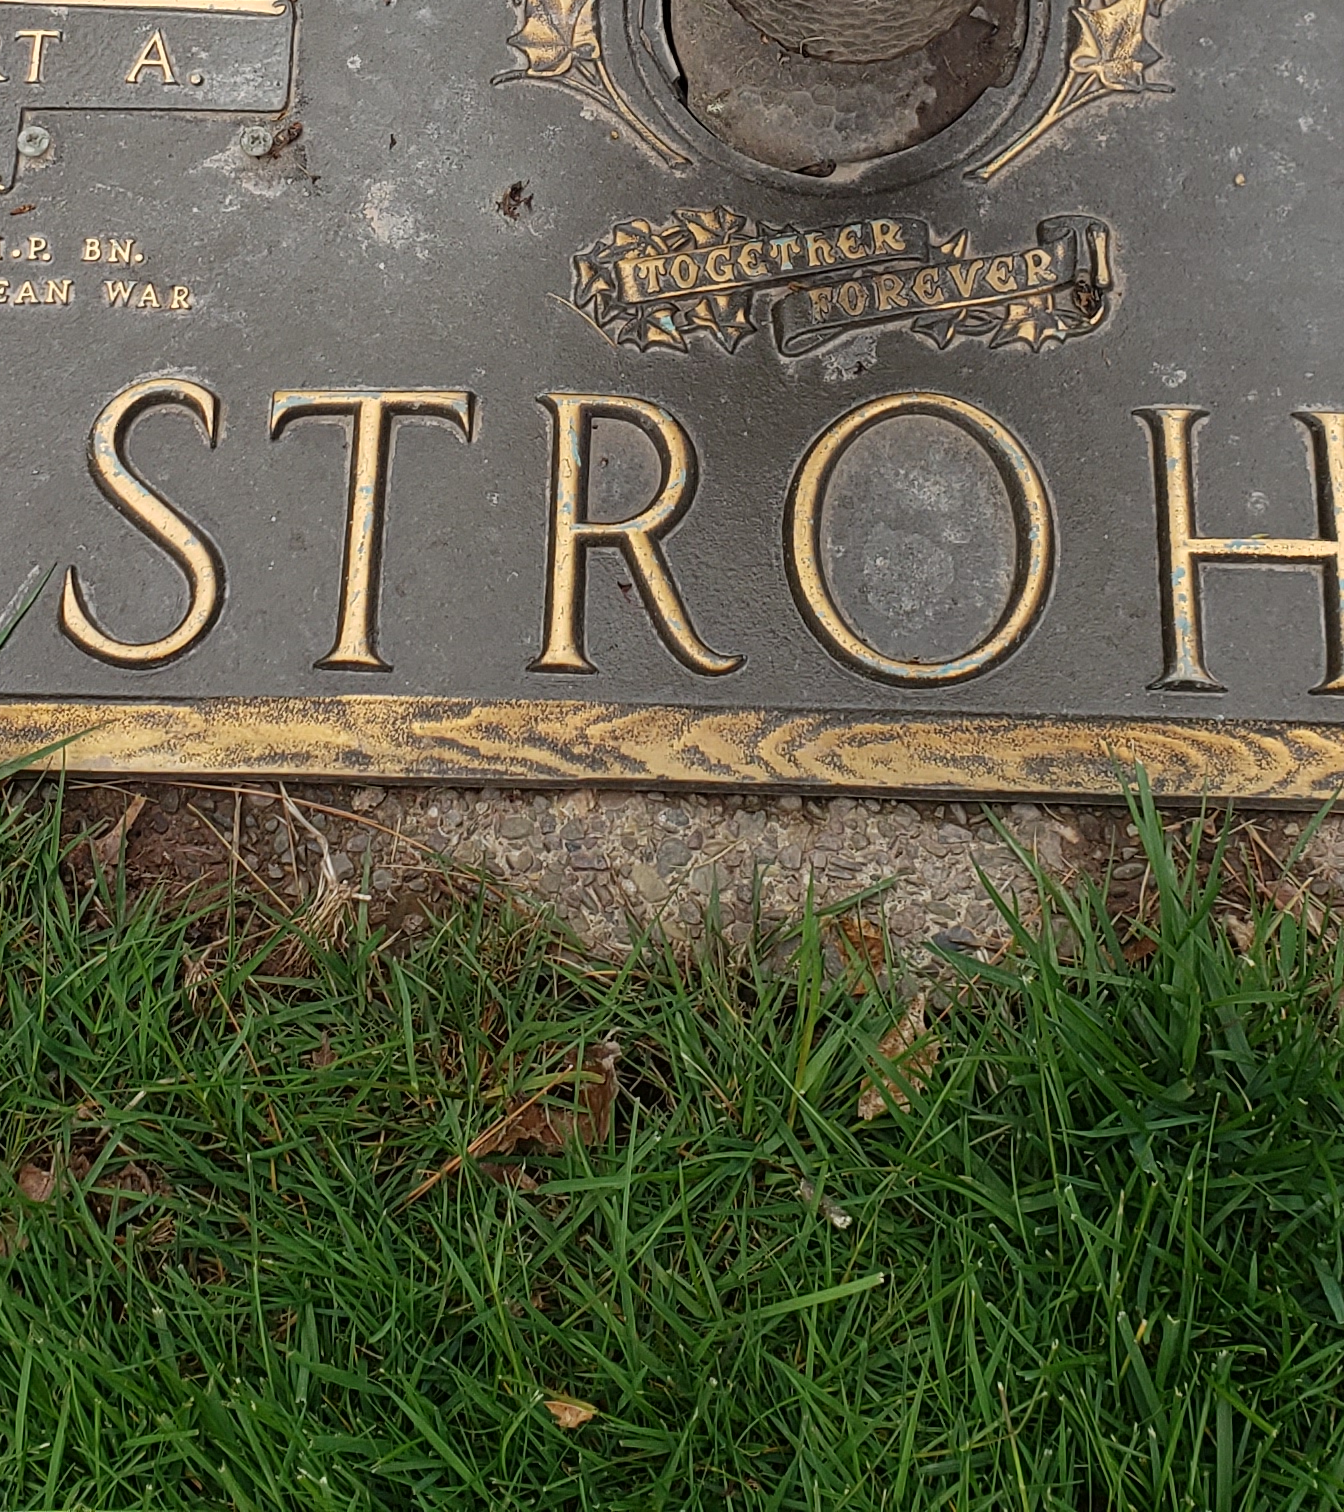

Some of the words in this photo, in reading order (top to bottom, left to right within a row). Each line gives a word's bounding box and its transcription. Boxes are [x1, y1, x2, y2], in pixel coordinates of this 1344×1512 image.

[126, 29, 207, 88] A.
[81, 237, 146, 264] BN.
[103, 280, 193, 311] WAR
[808, 248, 1057, 325] FOREVER
